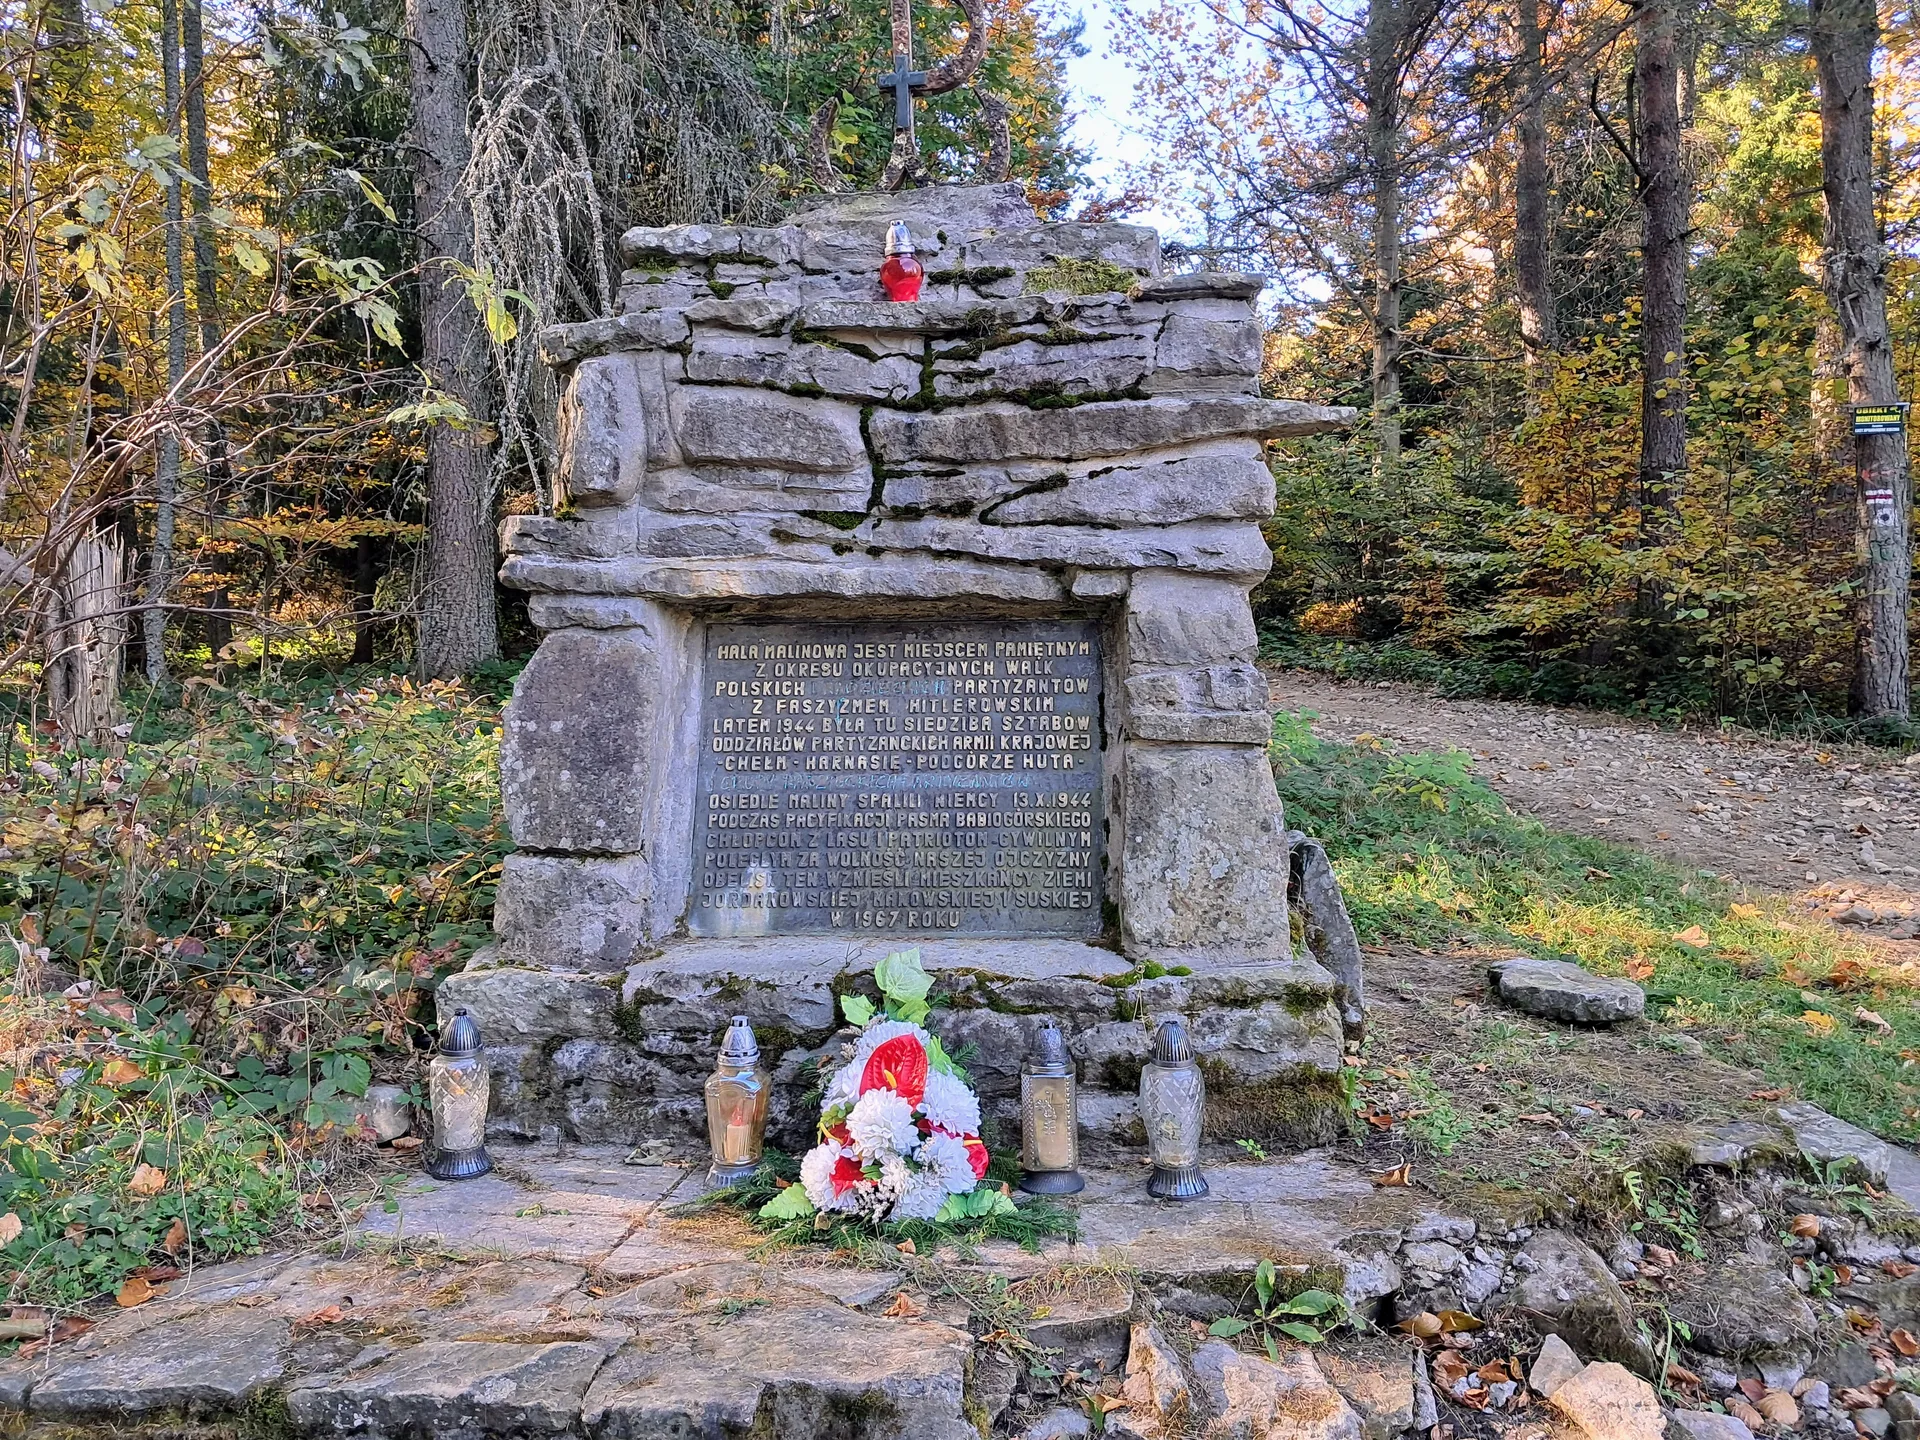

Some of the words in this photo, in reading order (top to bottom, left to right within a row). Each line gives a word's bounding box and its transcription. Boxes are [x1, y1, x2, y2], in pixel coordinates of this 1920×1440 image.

[717, 645, 758, 659] HALA
[764, 644, 847, 659] MALINOWA
[854, 644, 896, 659] JEST
[904, 643, 988, 658] MIEJSCEM
[995, 641, 1090, 661] PAMIĘTNYM
[756, 663, 766, 678] Z
[775, 662, 842, 678] OKRESU
[852, 661, 994, 677] OKUPACYJNYCH
[1006, 660, 1053, 676] WALK
[716, 681, 806, 696] POLSKICH
[954, 675, 1089, 694] PARTYZANTÓW
[752, 699, 763, 714] Z
[777, 699, 889, 714] FASZYZMEM
[909, 697, 1054, 713] HITLEROWSKIM
[713, 718, 771, 733] LATEM
[777, 718, 815, 733] 1944
[822, 717, 865, 733] BYŁA
[874, 717, 896, 732] TU
[904, 716, 992, 732] SIEDZIBA
[1002, 712, 1090, 731] SZTABÓW
[712, 734, 806, 752] ODDZIAŁÓW
[812, 736, 947, 752] PARTYZANCKICH
[953, 736, 994, 751] ARMII
[1001, 735, 1091, 750] KRAJOWEJ
[806, 755, 900, 770] HARNASIE
[916, 751, 1014, 770] PODGÓRZE
[709, 794, 779, 809] OSIEDLE
[789, 794, 848, 809] MALINY
[858, 794, 921, 809] SPALILI
[935, 793, 999, 808] NIEMCY
[1014, 793, 1091, 808] 13.X.1944
[708, 813, 780, 829] PODCZAS
[786, 813, 890, 829] PACYFIKACJI
[897, 812, 949, 828] PASMA
[956, 808, 1091, 827] BABIOGÓRSKIEGO
[706, 833, 801, 849] CHŁOPCOM
[808, 833, 819, 848] Z
[827, 832, 869, 848] LASU
[889, 832, 988, 848] PATRIOTOM
[999, 831, 1091, 847] CYWILNYM
[705, 852, 793, 868] POLEGŁYM
[798, 853, 820, 868] ZA
[827, 847, 907, 868] WOLNOŚĆ
[914, 852, 987, 867] NASZEJ
[994, 851, 1090, 867] OJCZYZNY
[703, 871, 775, 889] OBELISK
[784, 872, 819, 888] TEN
[826, 869, 909, 888] WZNIEŚLI
[920, 868, 1032, 887] MIESZKAŃCY
[1043, 871, 1091, 887] ZIEMI
[701, 891, 860, 908] JORDANOWSKIEJ
[873, 891, 994, 908] MAKOWSKIEJ
[1015, 891, 1091, 908] SUSKIEJ
[830, 912, 844, 927] W
[854, 911, 899, 927] 1967
[908, 911, 961, 927] ROKU
